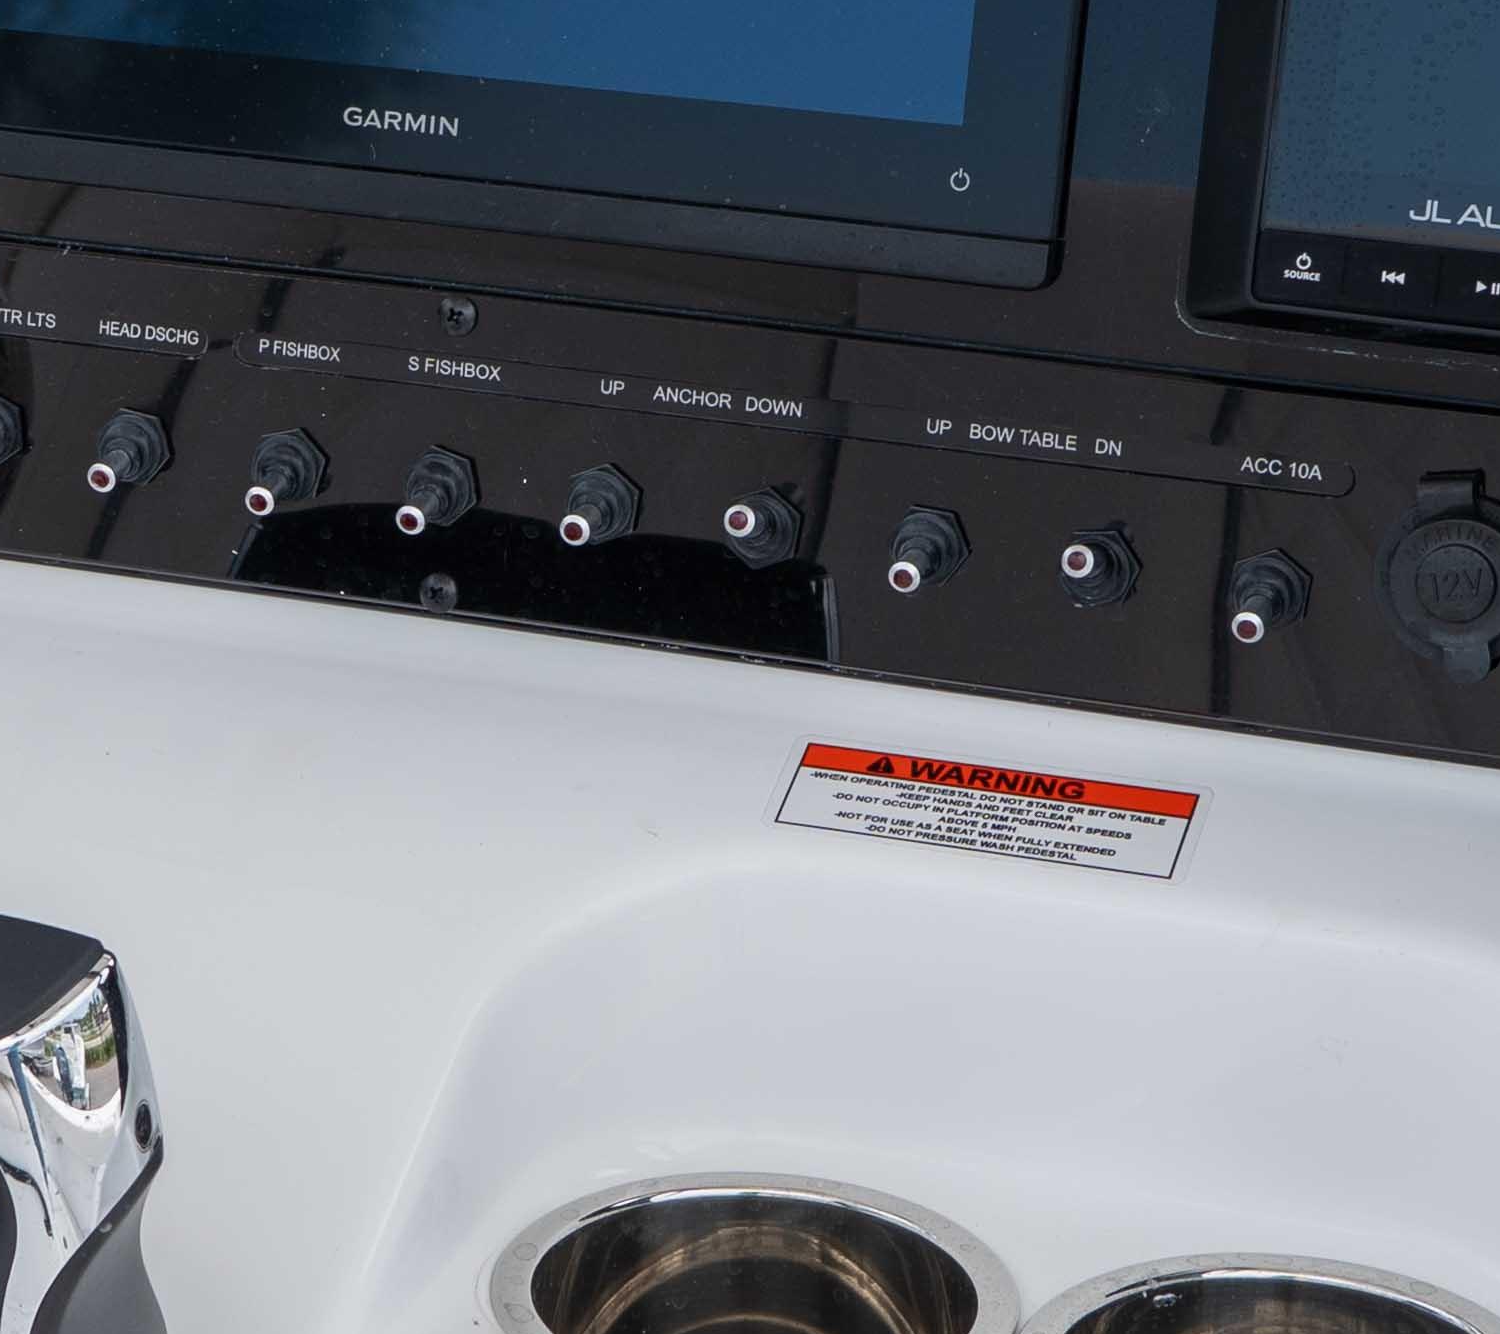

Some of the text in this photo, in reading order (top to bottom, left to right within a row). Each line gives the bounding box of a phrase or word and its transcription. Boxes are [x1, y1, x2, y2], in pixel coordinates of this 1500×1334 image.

[342, 105, 460, 138] GARMIN
[1409, 199, 1451, 224] JL
[1283, 268, 1321, 282] SOURCE
[26, 310, 57, 329] LTS
[99, 319, 200, 346] HEAD DSCHG
[259, 338, 342, 363] P FISHBOX
[407, 356, 502, 382] S FISHBOX
[600, 379, 803, 418] UP ANCHOR DOWN
[927, 418, 1122, 457] UP BOW TABLE DN
[1240, 456, 1323, 482] ACC 10A
[1428, 567, 1484, 603] 12V
[909, 759, 1086, 800] WARNING
[933, 797, 972, 810] HANDS
[976, 803, 999, 814] AND
[1002, 806, 1031, 818] FEET
[1034, 809, 1074, 822] CLEAR
